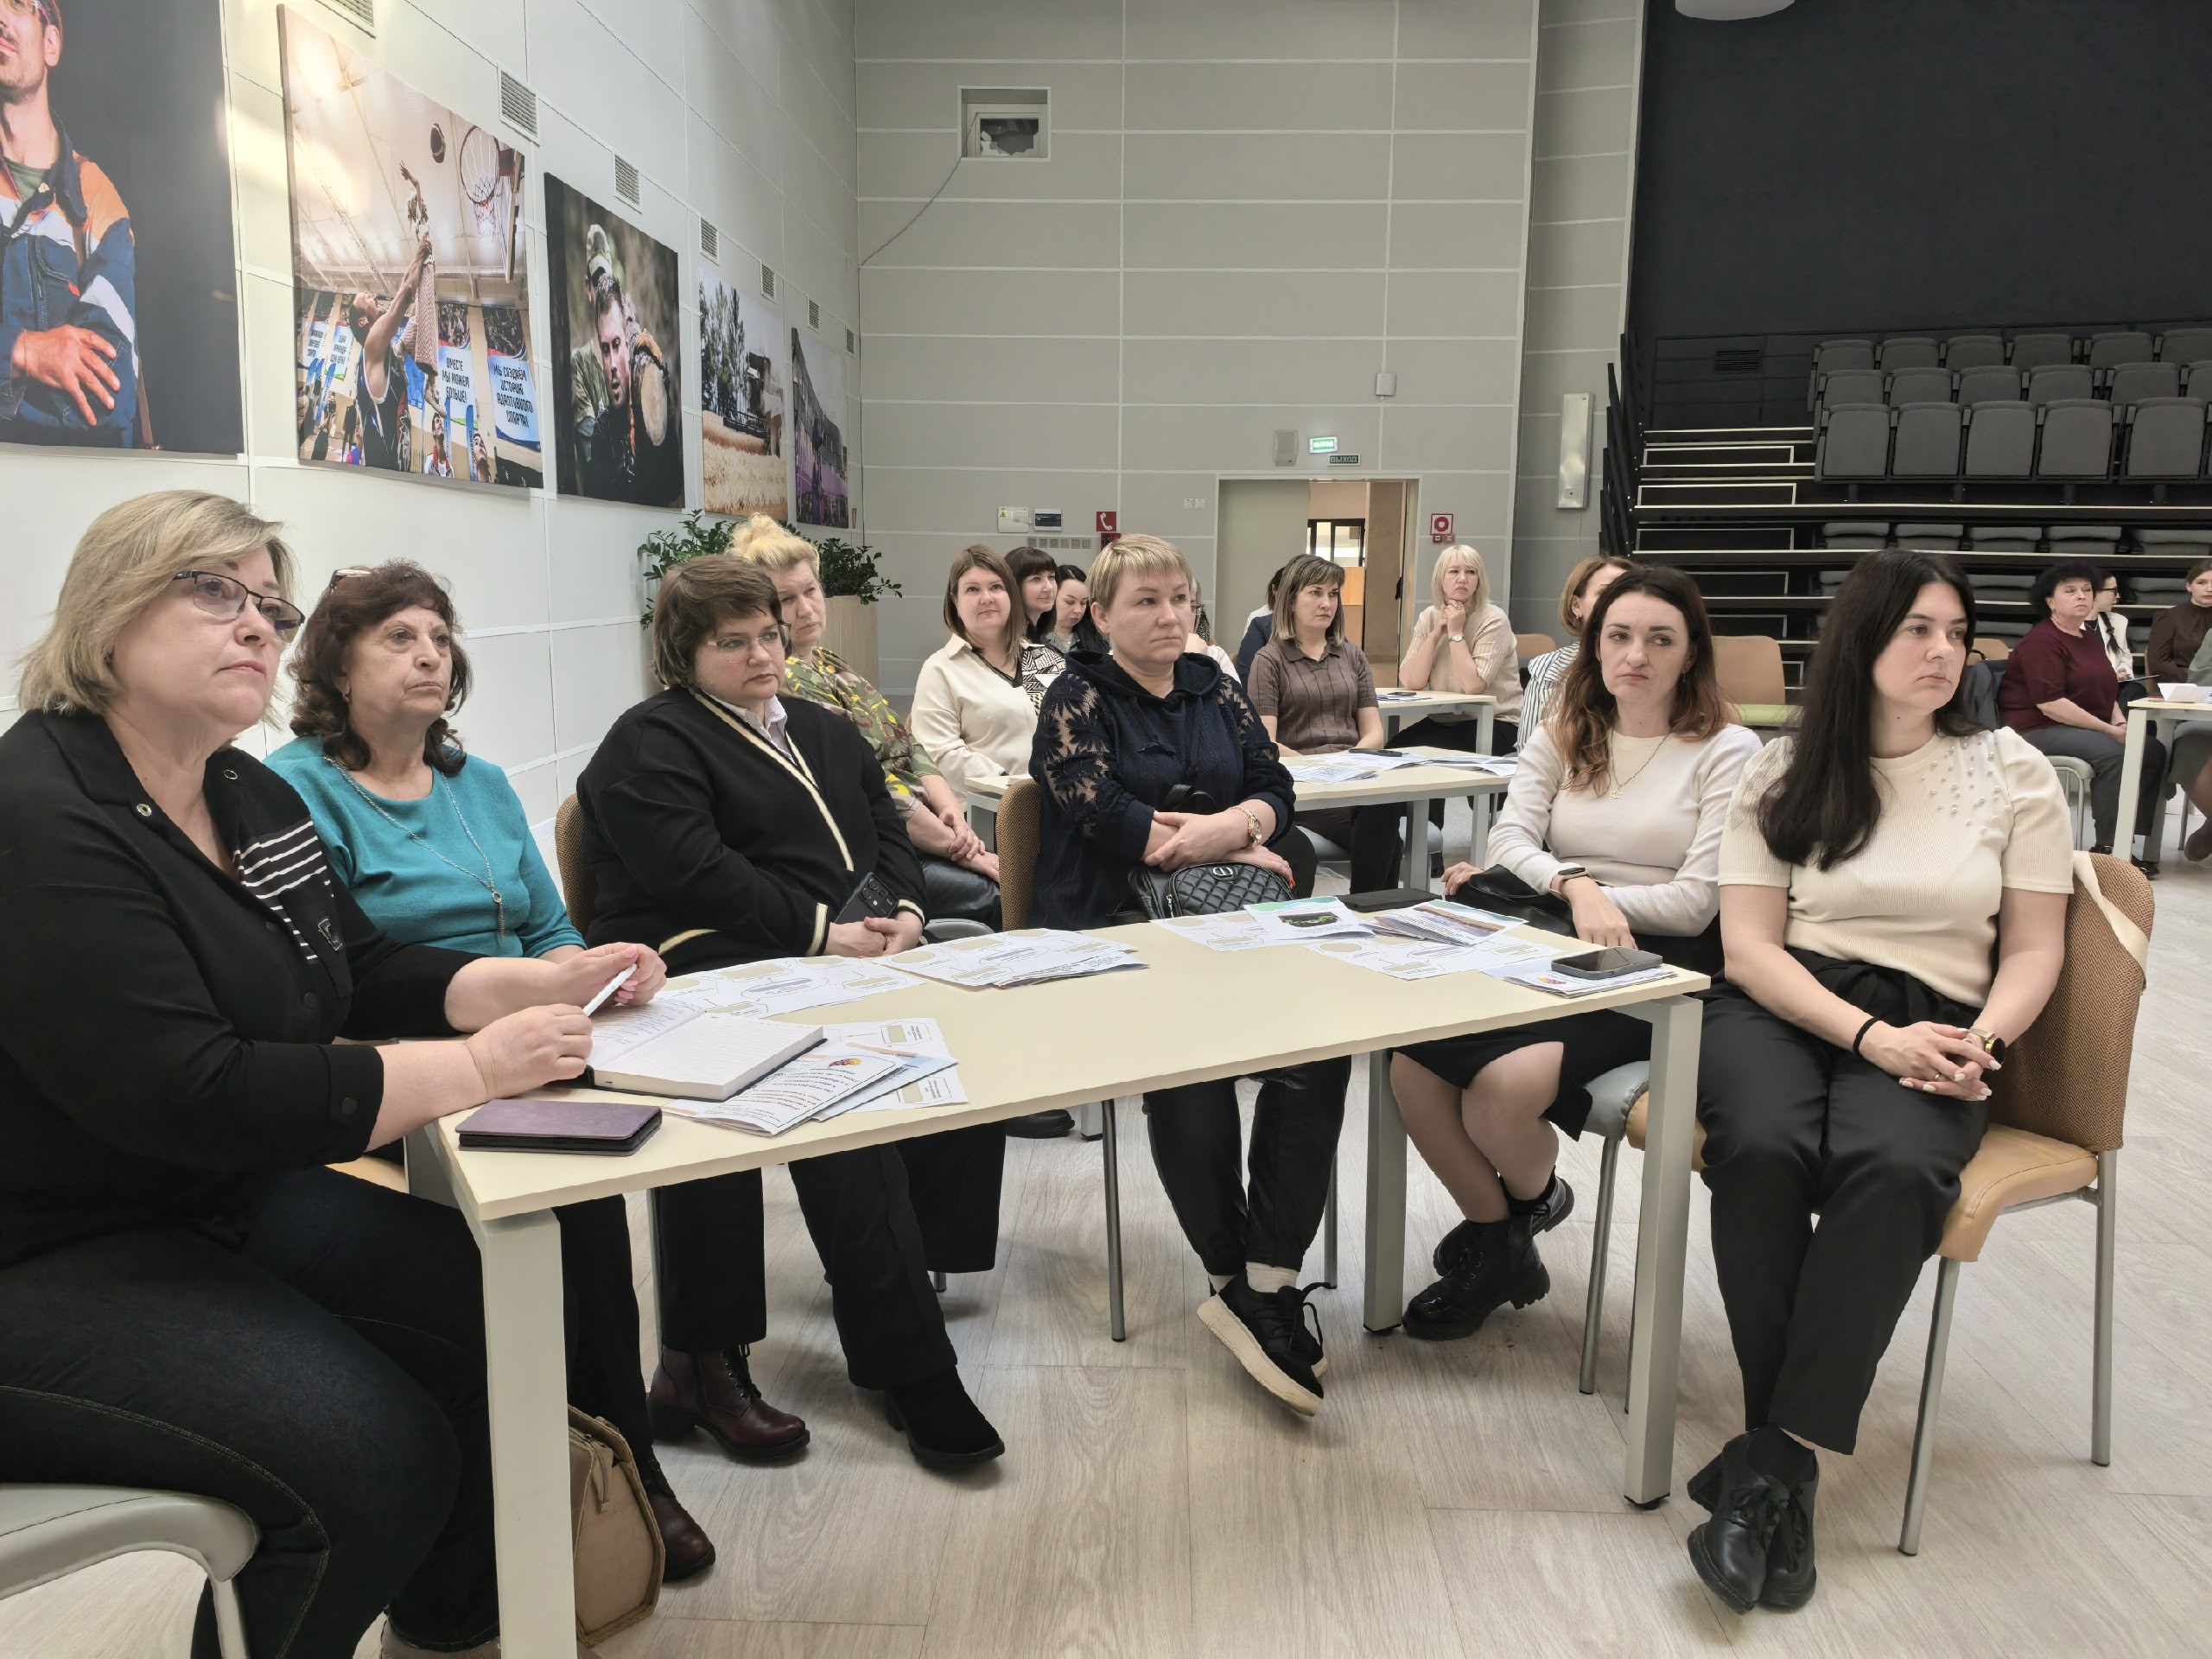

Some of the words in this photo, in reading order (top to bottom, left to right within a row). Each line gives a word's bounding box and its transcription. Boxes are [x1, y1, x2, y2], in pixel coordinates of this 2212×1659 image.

[446, 358, 463, 371] ВМЕСТЕ
[493, 365, 502, 376] МЫ
[442, 370, 450, 383] МЫ
[451, 372, 469, 388] МОЖЕМ
[446, 386, 467, 404] БОЛЬШЕ!
